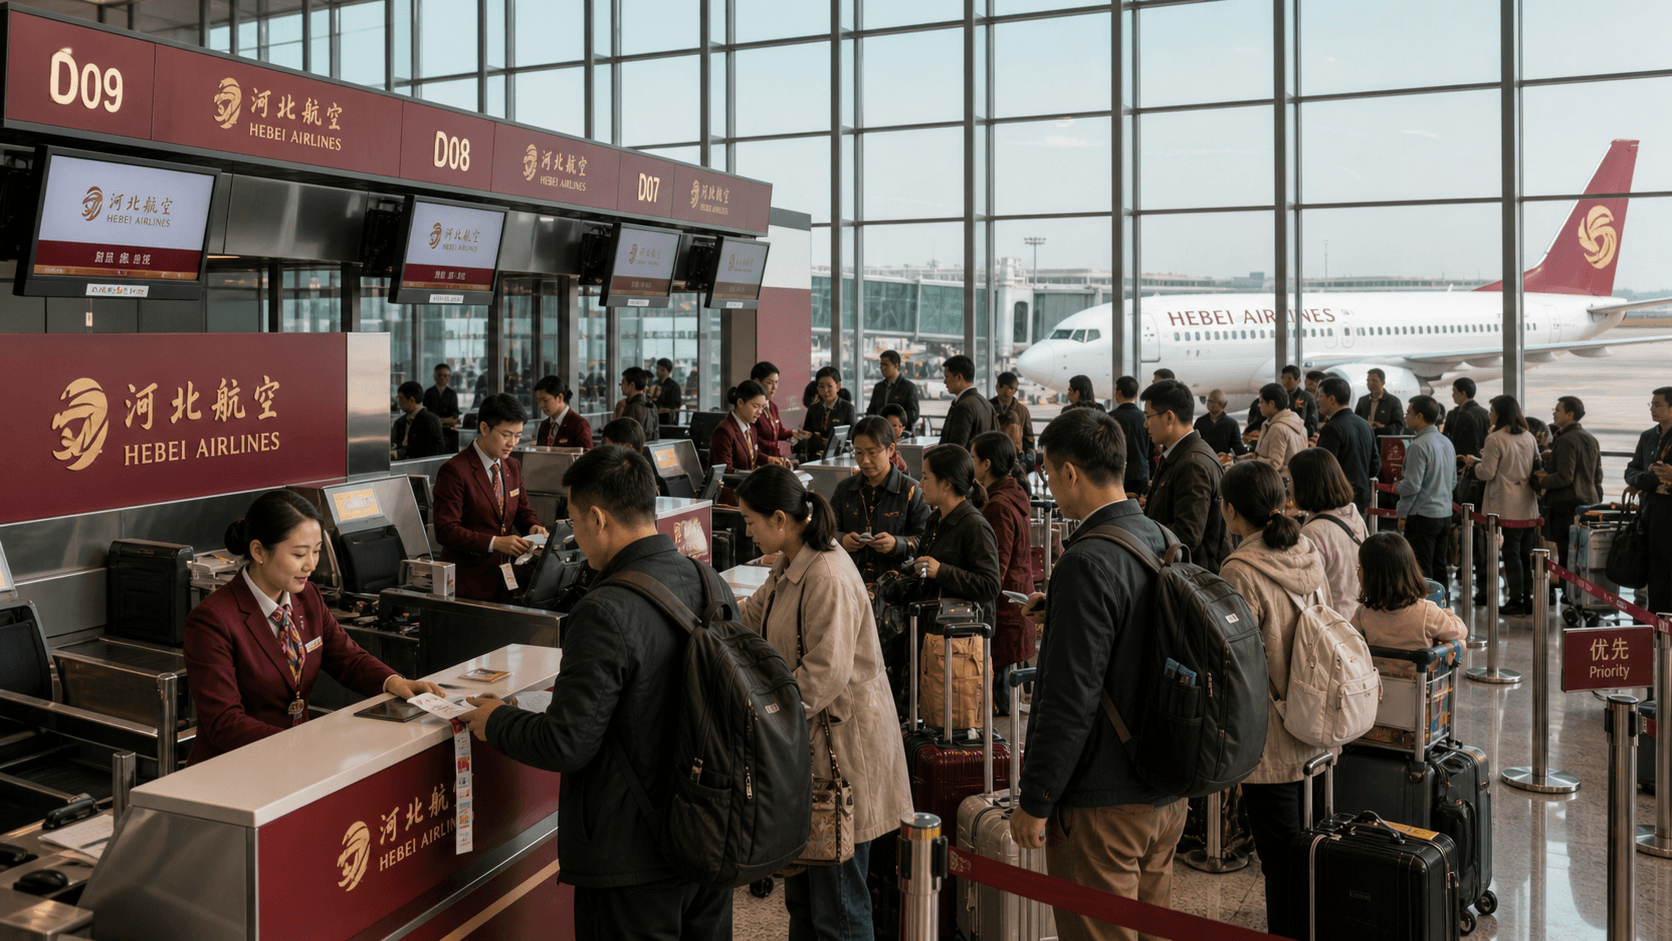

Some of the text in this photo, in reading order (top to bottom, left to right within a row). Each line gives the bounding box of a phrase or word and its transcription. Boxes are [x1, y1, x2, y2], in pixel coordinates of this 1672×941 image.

[49, 47, 124, 113] D09
[250, 86, 343, 131] 河北航空
[249, 122, 343, 151] HEBEI AIRLINES
[433, 130, 471, 172] D08
[541, 149, 588, 177] 河北航空
[637, 172, 661, 203] D07
[109, 193, 173, 215] 河北航空
[106, 214, 171, 228] HEBEI AIRLINES
[1167, 309, 1234, 326] HEBEI
[1243, 308, 1336, 324] AIRINES
[124, 374, 281, 431] 河北航空
[123, 431, 281, 466] HEBEI AIRLINES
[1589, 637, 1629, 662] 优先
[1589, 663, 1630, 680] Priority
[379, 783, 457, 845] 河北航
[379, 838, 416, 872] HEBEI
